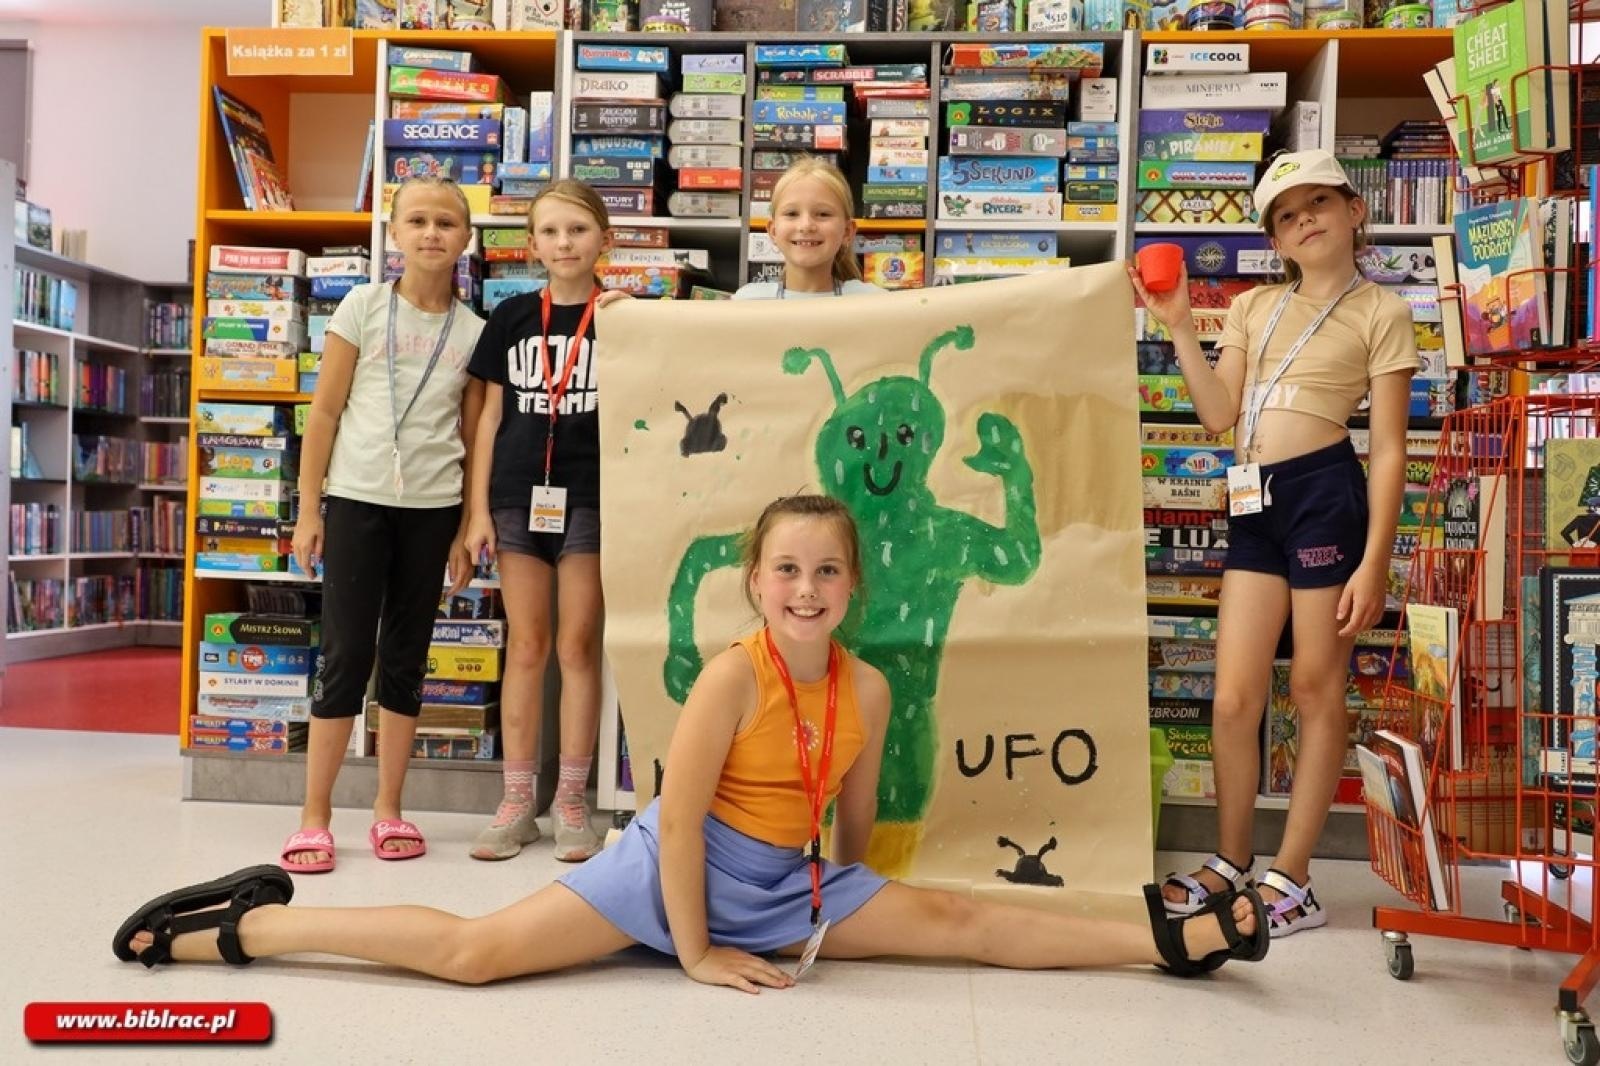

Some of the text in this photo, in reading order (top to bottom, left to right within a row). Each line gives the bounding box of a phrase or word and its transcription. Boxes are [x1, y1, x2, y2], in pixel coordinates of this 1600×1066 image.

[1466, 22, 1508, 54] CHEAT
[232, 44, 347, 60] Książka za 1 zł
[1190, 52, 1242, 62] ICECOOL
[1467, 43, 1508, 72] SHEET
[815, 71, 874, 81] SCRABBLE
[977, 106, 1055, 117] LOGIX
[403, 124, 480, 140] SEQUENCE
[953, 158, 1037, 186] 5 SEKUND
[602, 196, 634, 204] NTURY
[981, 202, 1024, 215] RYCERZ
[1171, 488, 1201, 498] BAŚNI
[272, 625, 302, 636] SŁOWA
[224, 678, 253, 686] SYLABY
[264, 679, 299, 687] DOMINIE
[1149, 707, 1201, 719] ZBRODNI
[955, 729, 1098, 785] UFO
[376, 821, 417, 835] Barbie
[288, 833, 332, 846] Barbie
